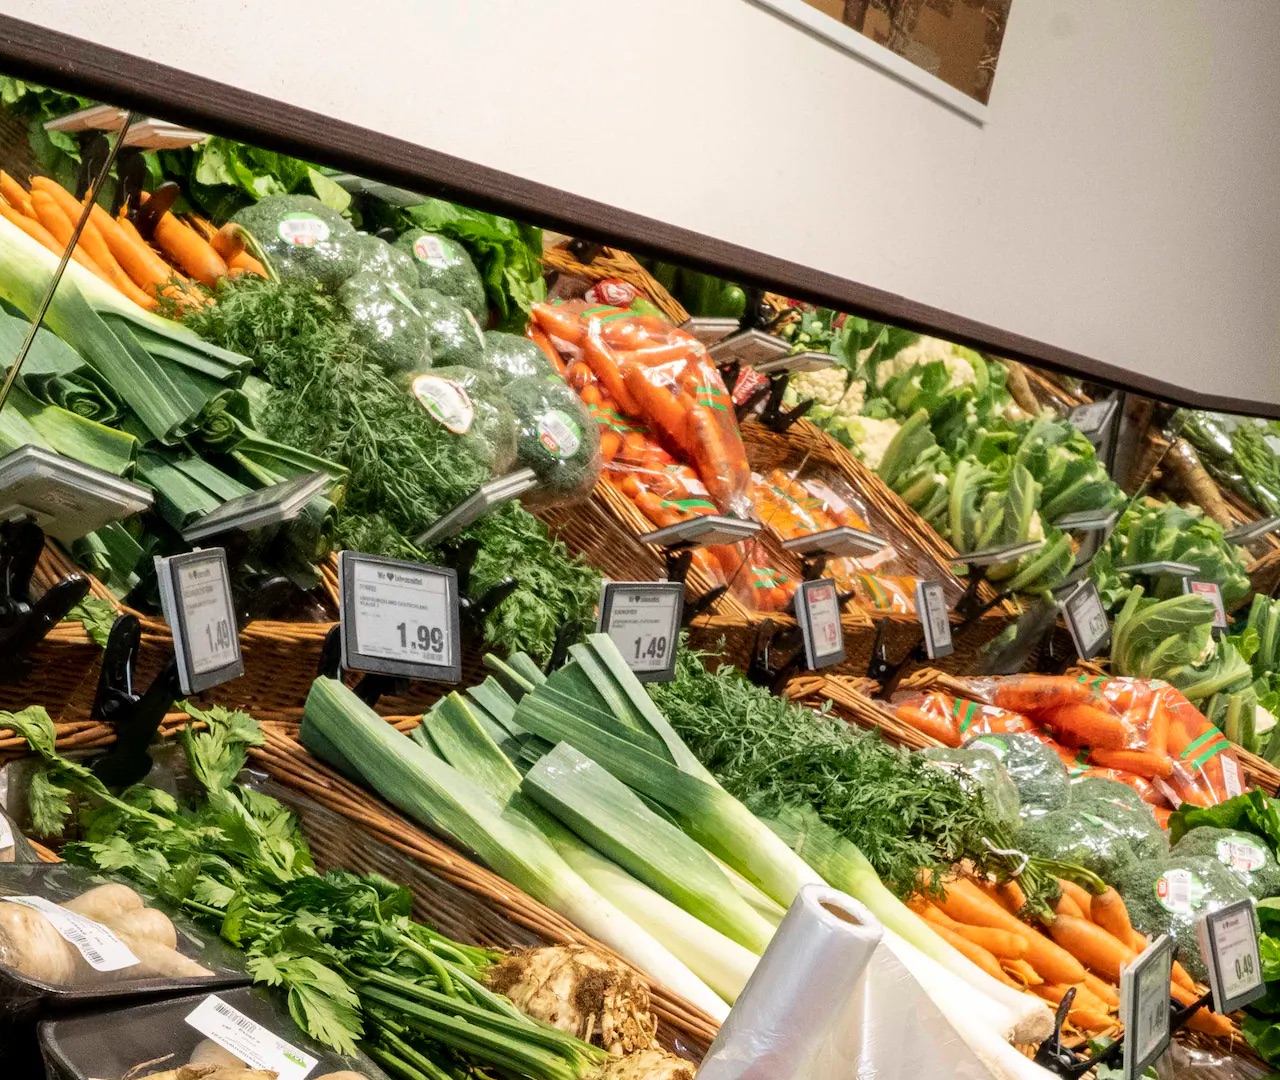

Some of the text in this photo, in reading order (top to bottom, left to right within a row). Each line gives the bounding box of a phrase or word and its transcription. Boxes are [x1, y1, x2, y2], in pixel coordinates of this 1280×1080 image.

[397, 622, 443, 653] 1.99
[634, 636, 667, 659] 1.49
[1234, 953, 1255, 980] 0.49
